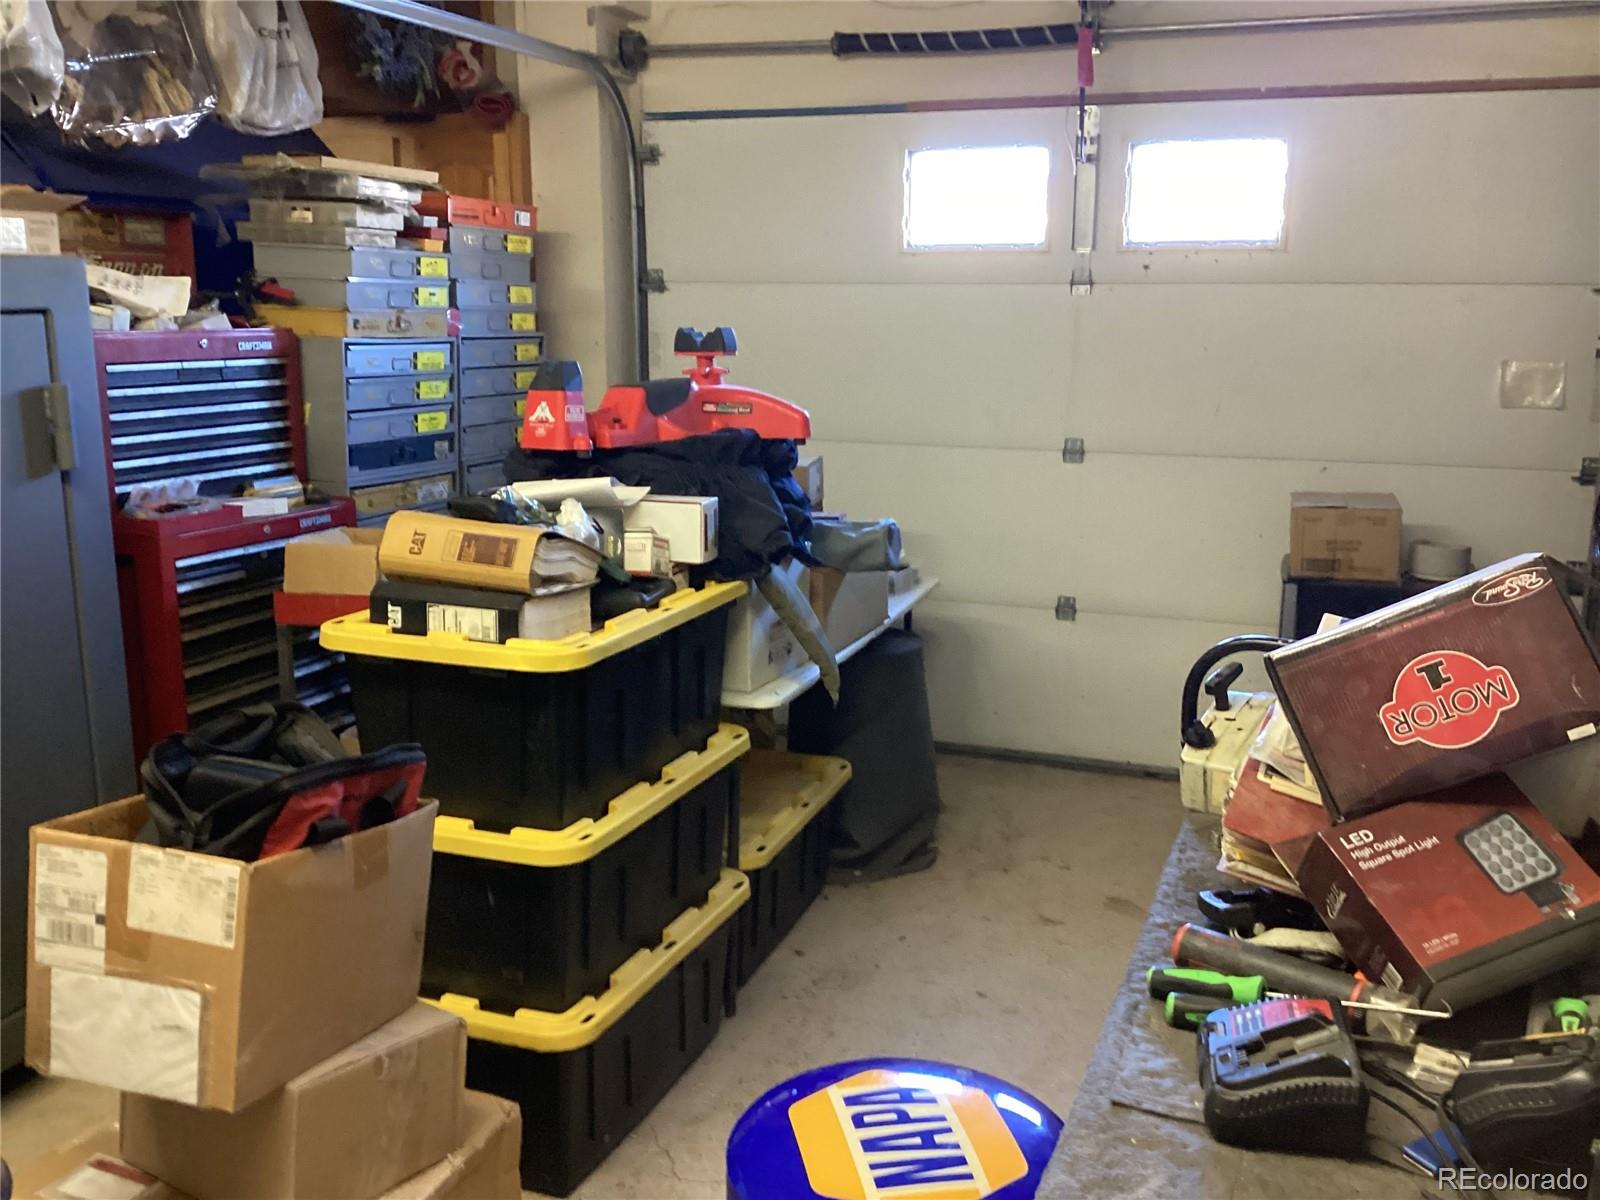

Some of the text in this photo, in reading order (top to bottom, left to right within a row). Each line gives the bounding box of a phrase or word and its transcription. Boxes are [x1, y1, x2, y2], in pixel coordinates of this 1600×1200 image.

[409, 529, 427, 556] CAT
[1415, 658, 1454, 692] 1
[1386, 674, 1511, 736] MOTOR
[1339, 829, 1375, 850] LED
[1350, 834, 1407, 861] High Output
[1358, 835, 1441, 871] Square Spot Light
[842, 1087, 976, 1190] NAPA
